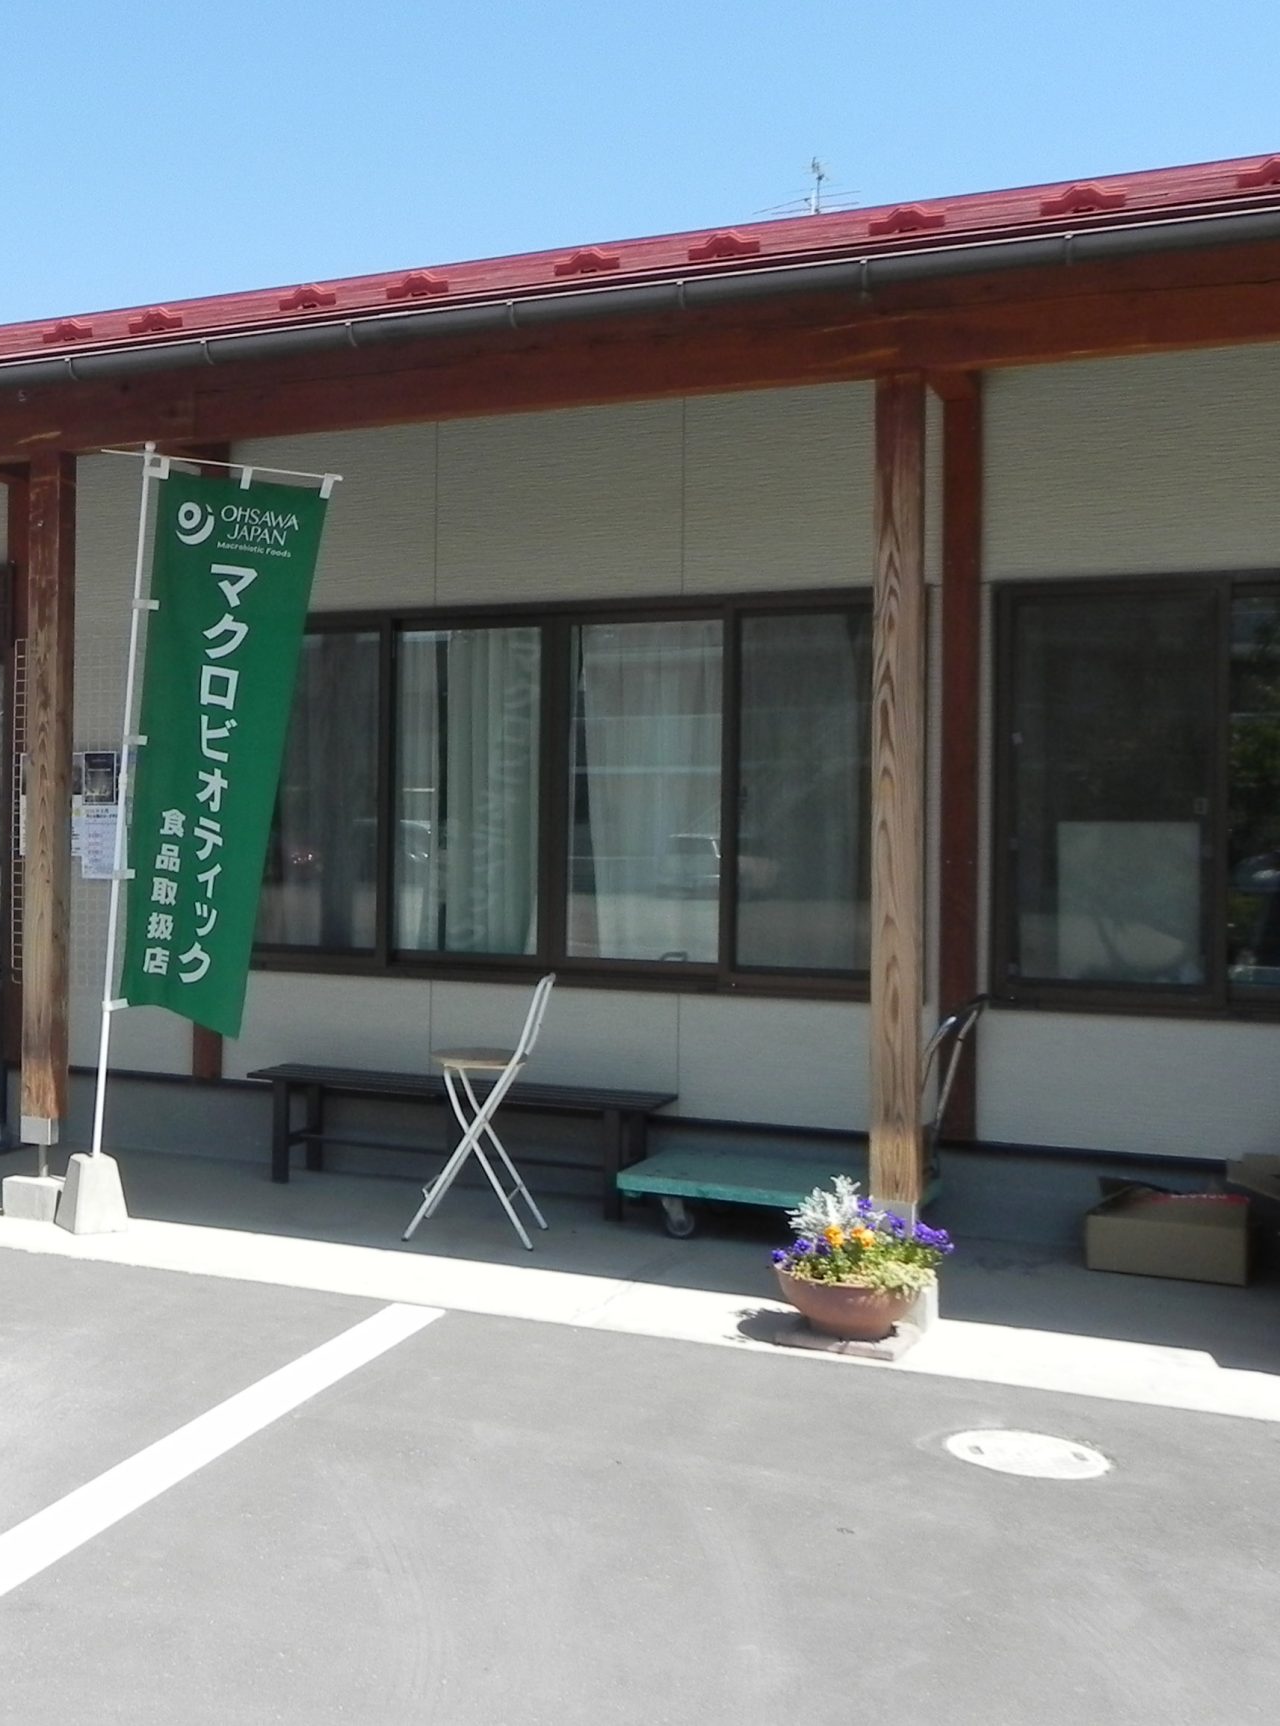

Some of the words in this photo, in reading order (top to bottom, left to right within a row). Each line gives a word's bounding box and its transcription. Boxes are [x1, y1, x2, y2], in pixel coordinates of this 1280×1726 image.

[221, 505, 299, 531] OHSAWA
[227, 524, 287, 546] JAPAN
[217, 541, 264, 554] Macrobiotic
[266, 548, 292, 558] Foods
[178, 562, 258, 984] マクロビオティック
[143, 808, 186, 975] 食品取扱店
